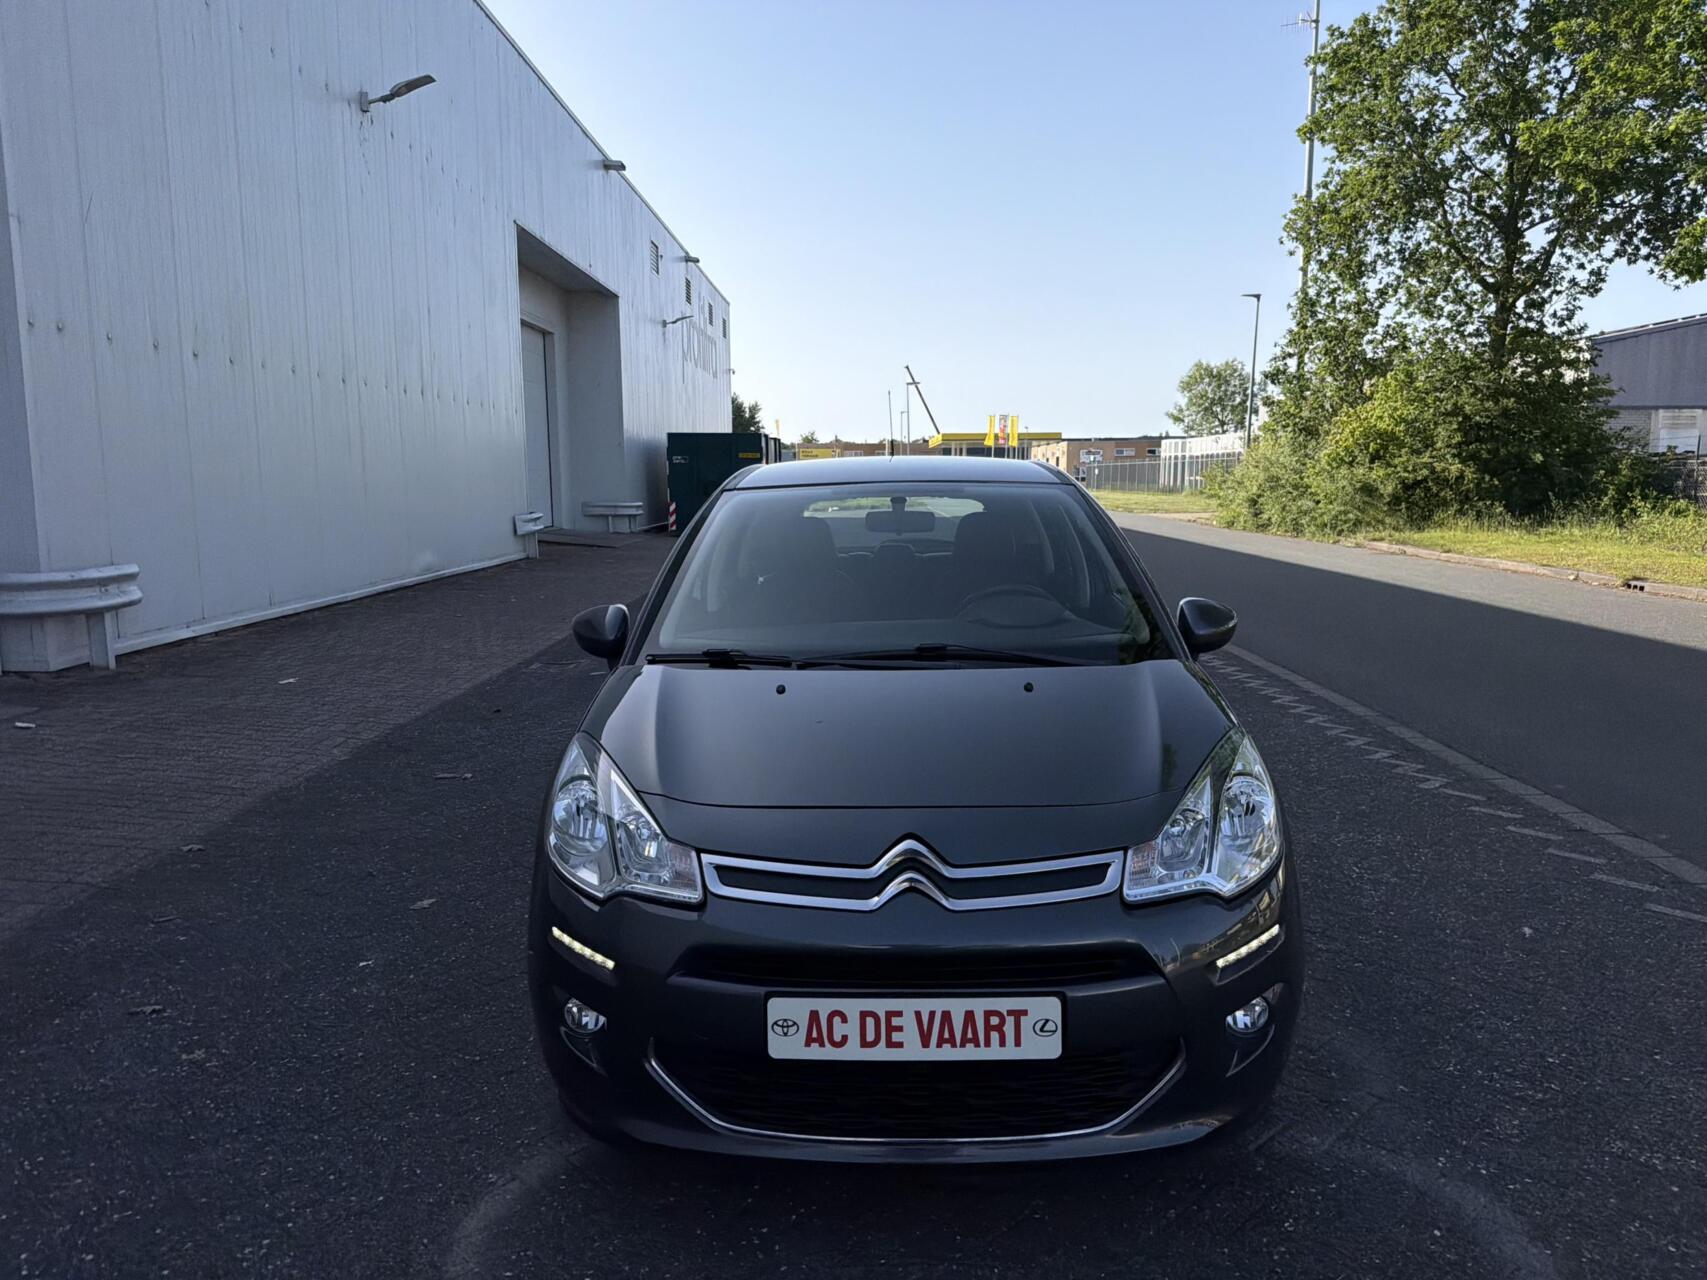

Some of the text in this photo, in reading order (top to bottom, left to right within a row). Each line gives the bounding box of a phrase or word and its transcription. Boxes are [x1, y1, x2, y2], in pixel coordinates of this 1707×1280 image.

[804, 1009, 1029, 1049] AC DE VAART
